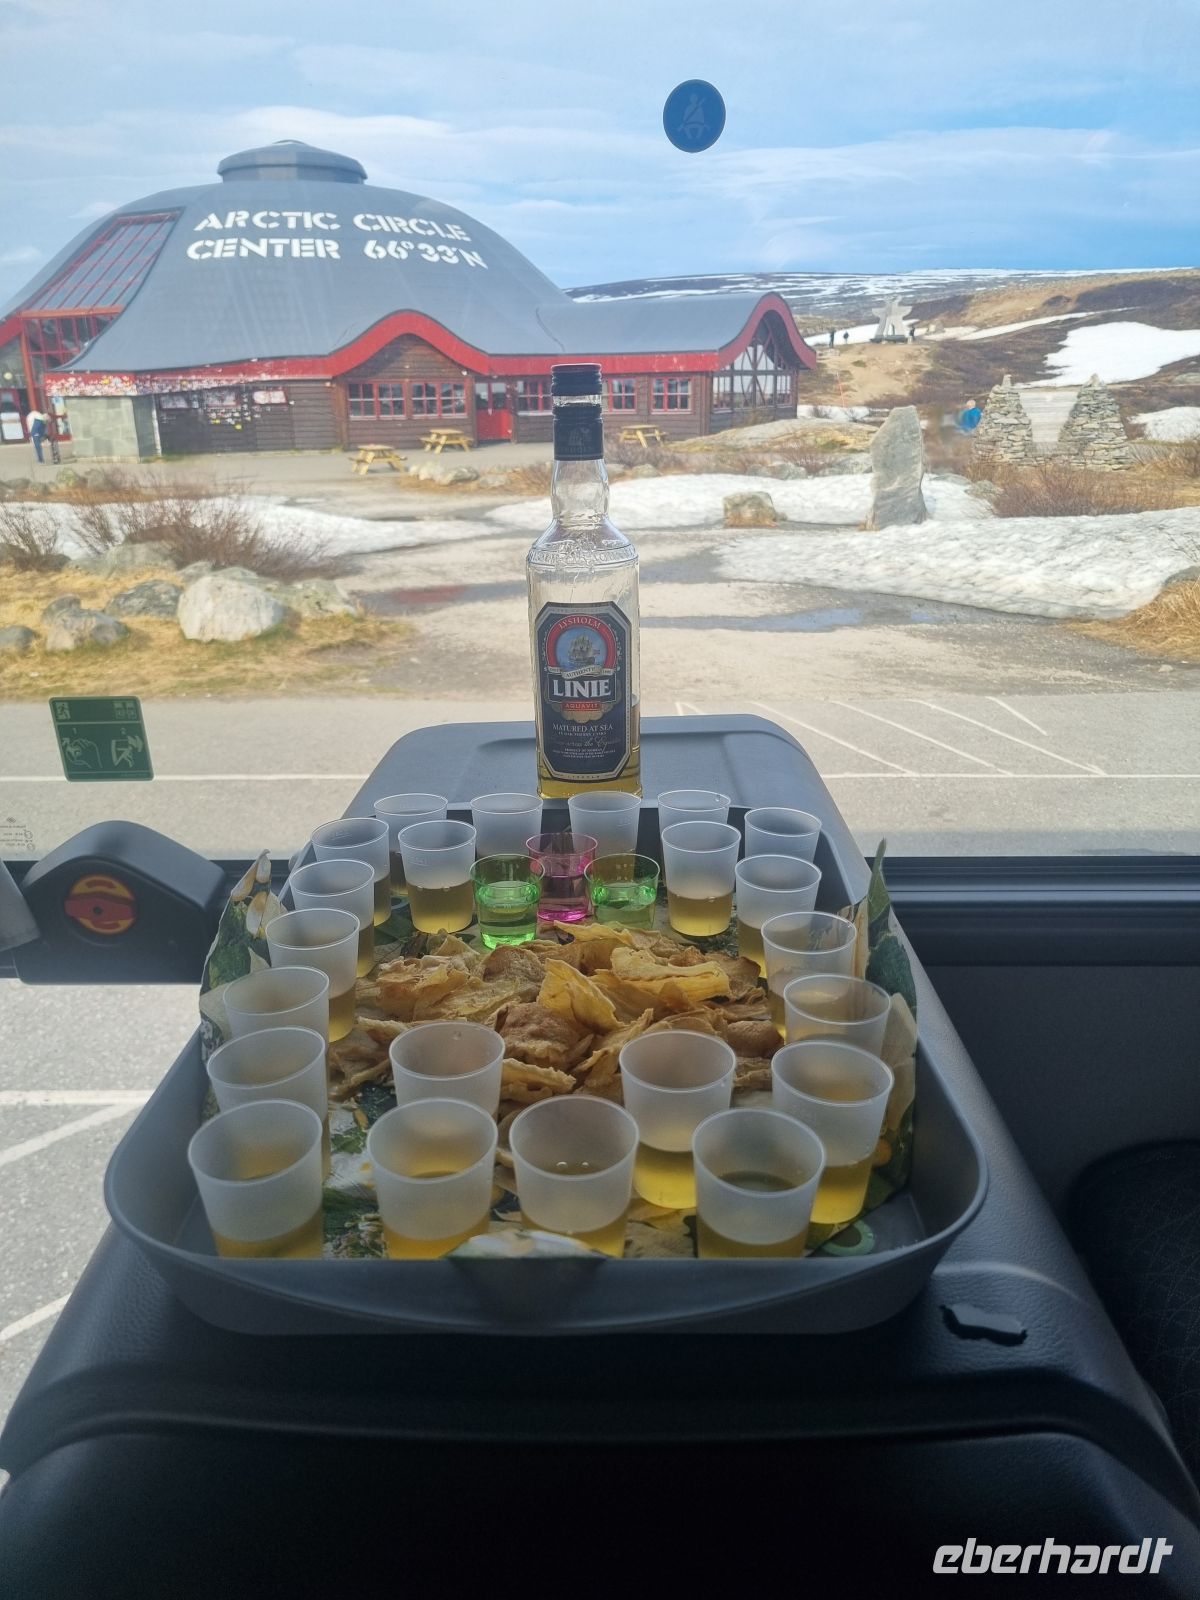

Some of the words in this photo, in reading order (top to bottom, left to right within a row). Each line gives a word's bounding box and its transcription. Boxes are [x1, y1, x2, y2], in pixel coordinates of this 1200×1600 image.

[193, 210, 341, 232] ARCTIC
[353, 213, 472, 242] CIRCLE
[187, 238, 341, 260] CENTER
[559, 616, 602, 630] LYSHOLM
[553, 679, 612, 699] LINIE
[564, 702, 598, 710] AQUAVIT
[552, 722, 588, 733] MATURED
[589, 724, 598, 732] AT
[600, 723, 614, 732] SEA
